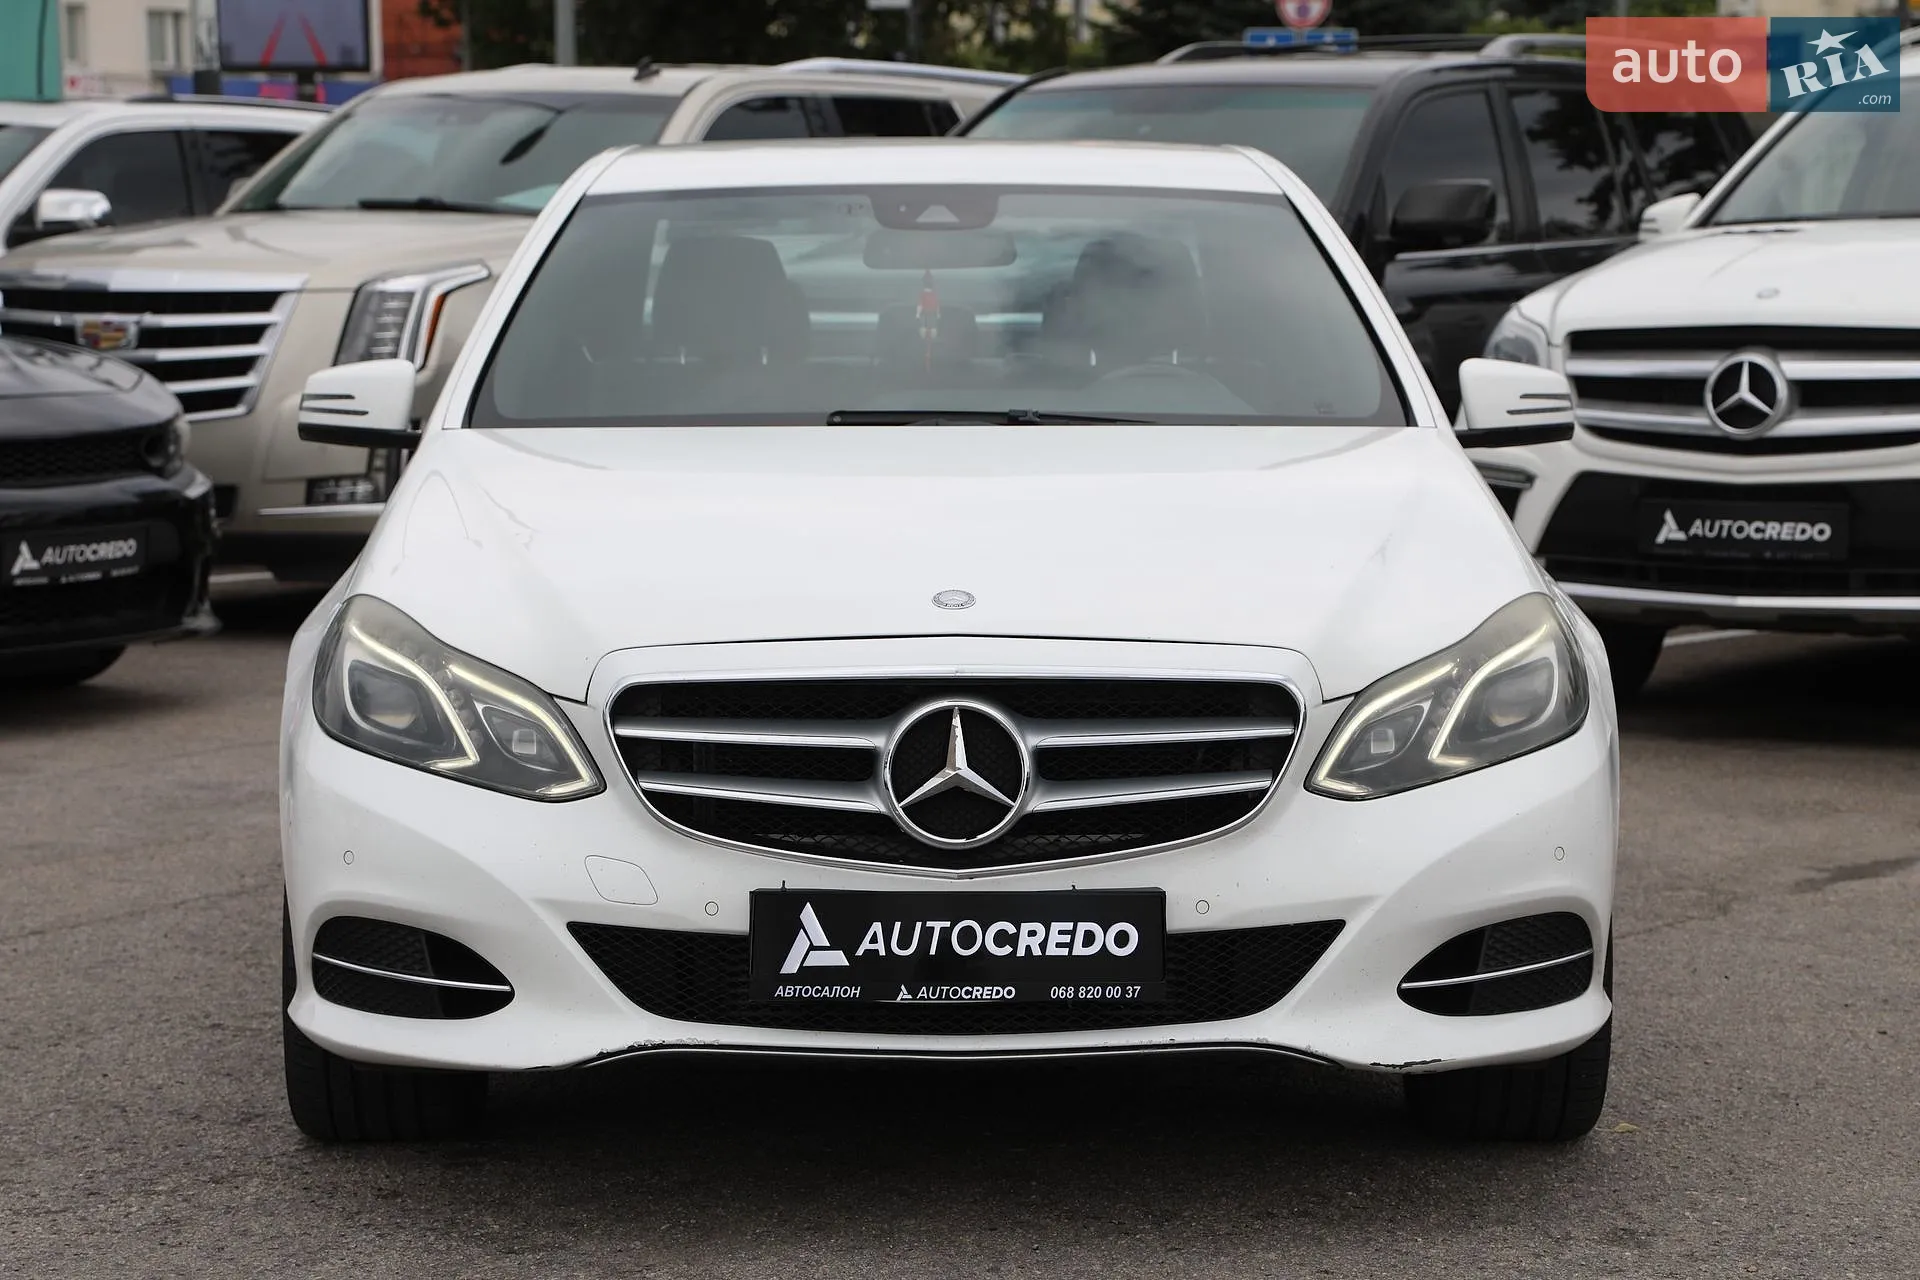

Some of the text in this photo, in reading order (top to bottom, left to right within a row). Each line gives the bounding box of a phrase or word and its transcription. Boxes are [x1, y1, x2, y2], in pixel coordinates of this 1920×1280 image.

[1687, 518, 1832, 542] AUTOCREDO
[40, 538, 137, 565] AUTOCREDO
[855, 920, 1139, 957] AUTOCREDO
[774, 985, 861, 998] АВТОСАЛОН
[917, 985, 1016, 999] AUTOCREDO
[1050, 985, 1142, 999] 068 820 00 37
